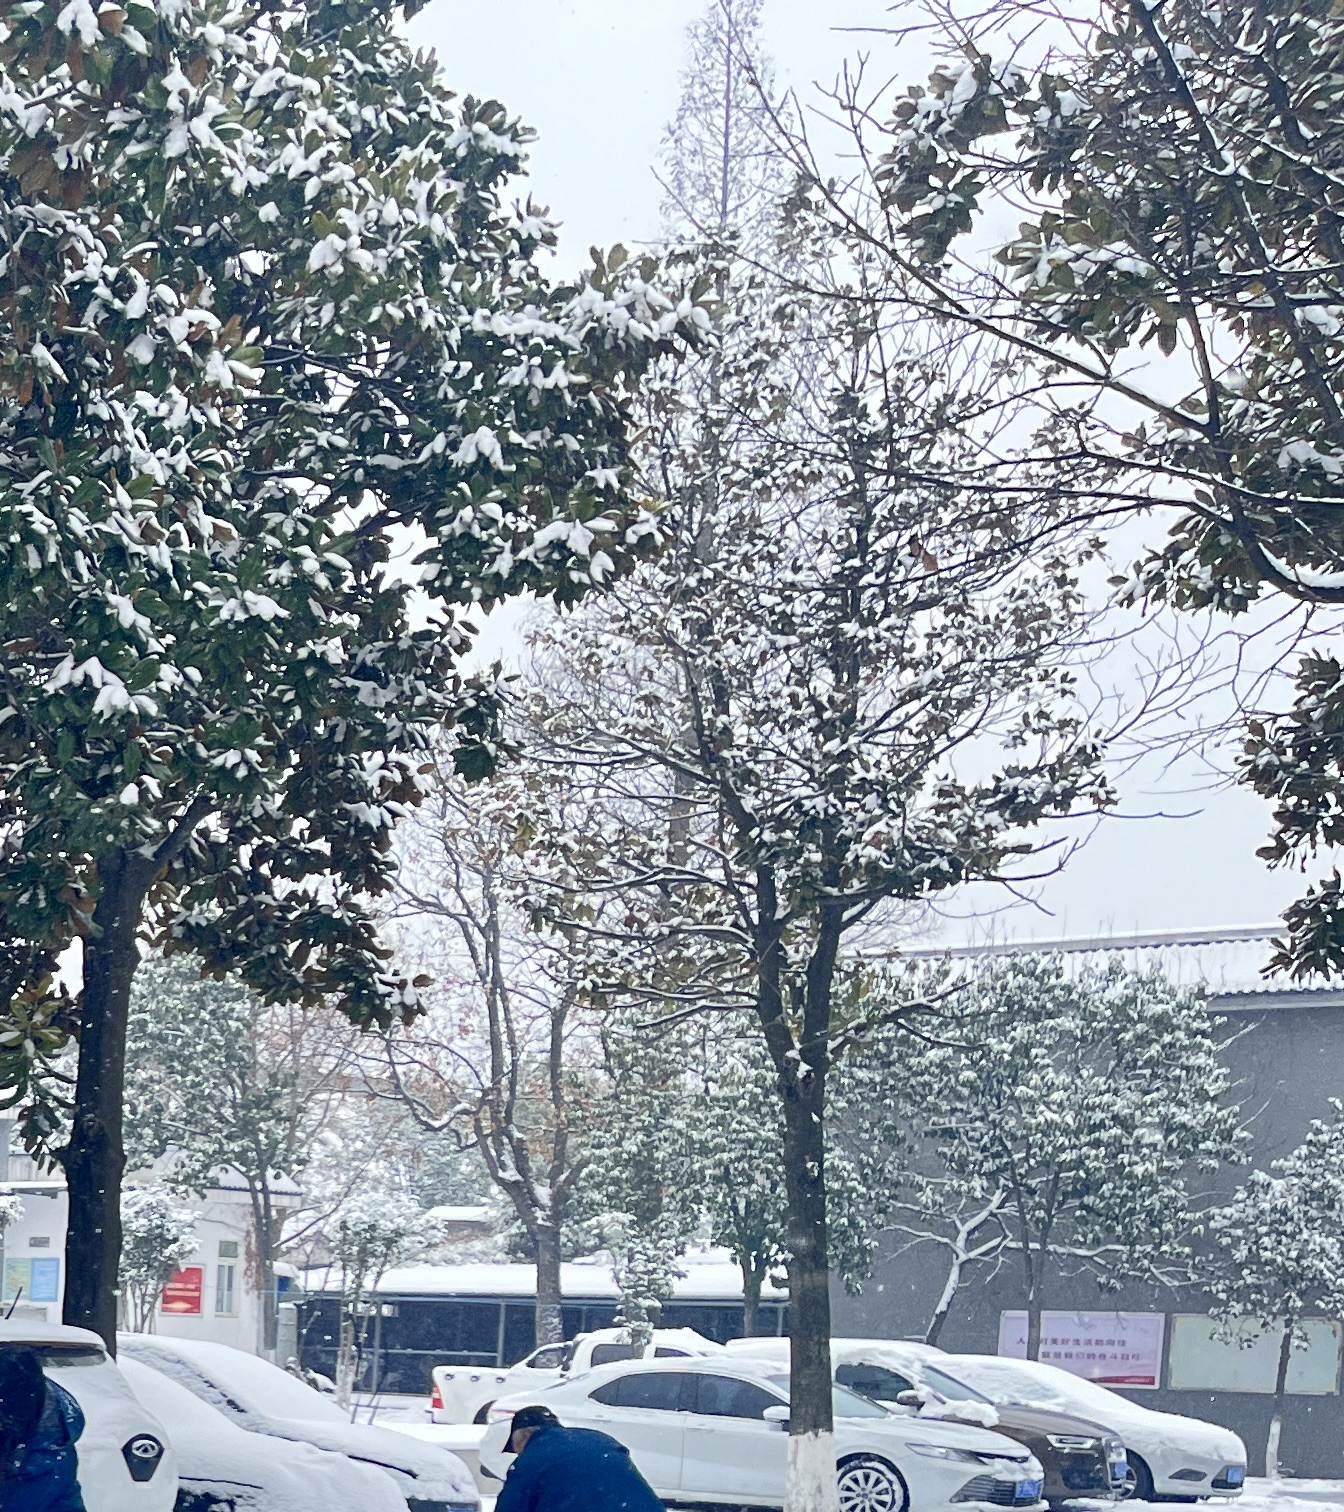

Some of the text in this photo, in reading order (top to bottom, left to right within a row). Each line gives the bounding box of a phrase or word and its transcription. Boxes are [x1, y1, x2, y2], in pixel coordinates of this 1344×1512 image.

[1016, 1337, 1127, 1347] 人对美好生活的向往
